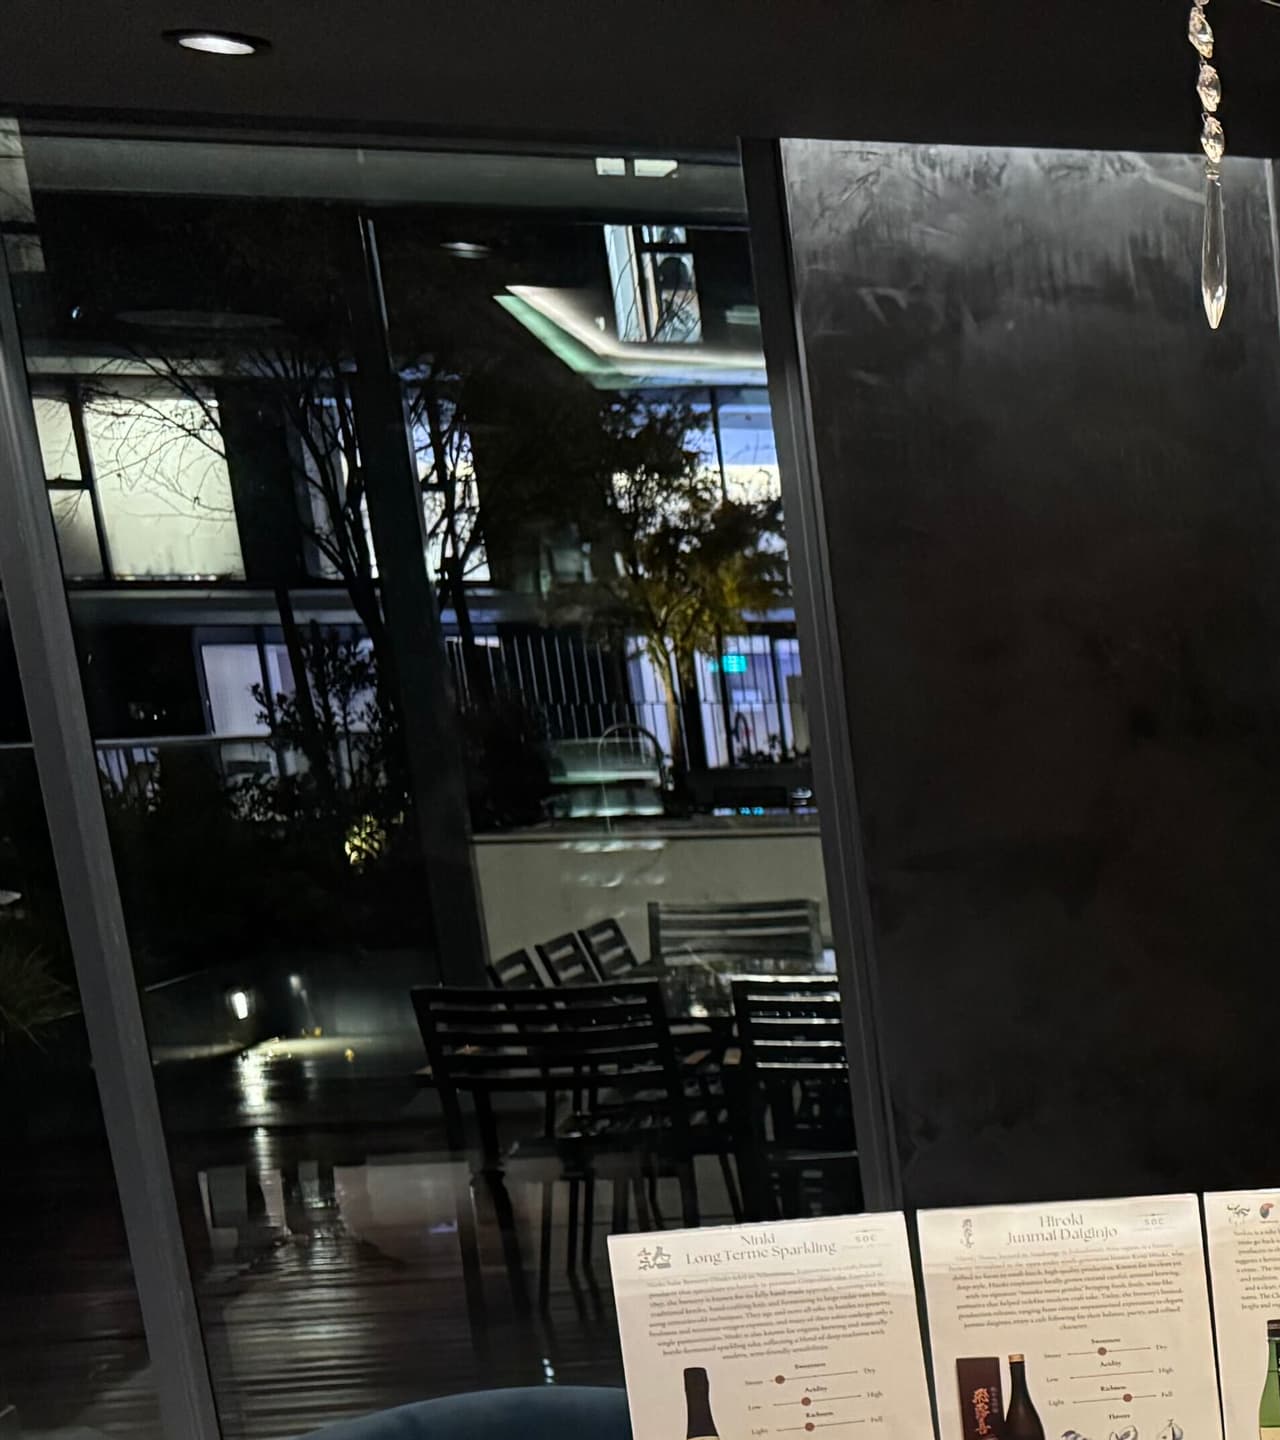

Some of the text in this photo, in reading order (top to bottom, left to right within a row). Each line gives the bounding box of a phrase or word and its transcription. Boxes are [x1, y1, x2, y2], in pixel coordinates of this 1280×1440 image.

[1040, 1213, 1083, 1227] Hiroki
[741, 1233, 775, 1245] Ninki
[1009, 1227, 1117, 1243] Junmai Daiginjo
[686, 1253, 722, 1265] Long
[724, 1250, 768, 1261] Terme
[769, 1240, 837, 1260] Sparkling
